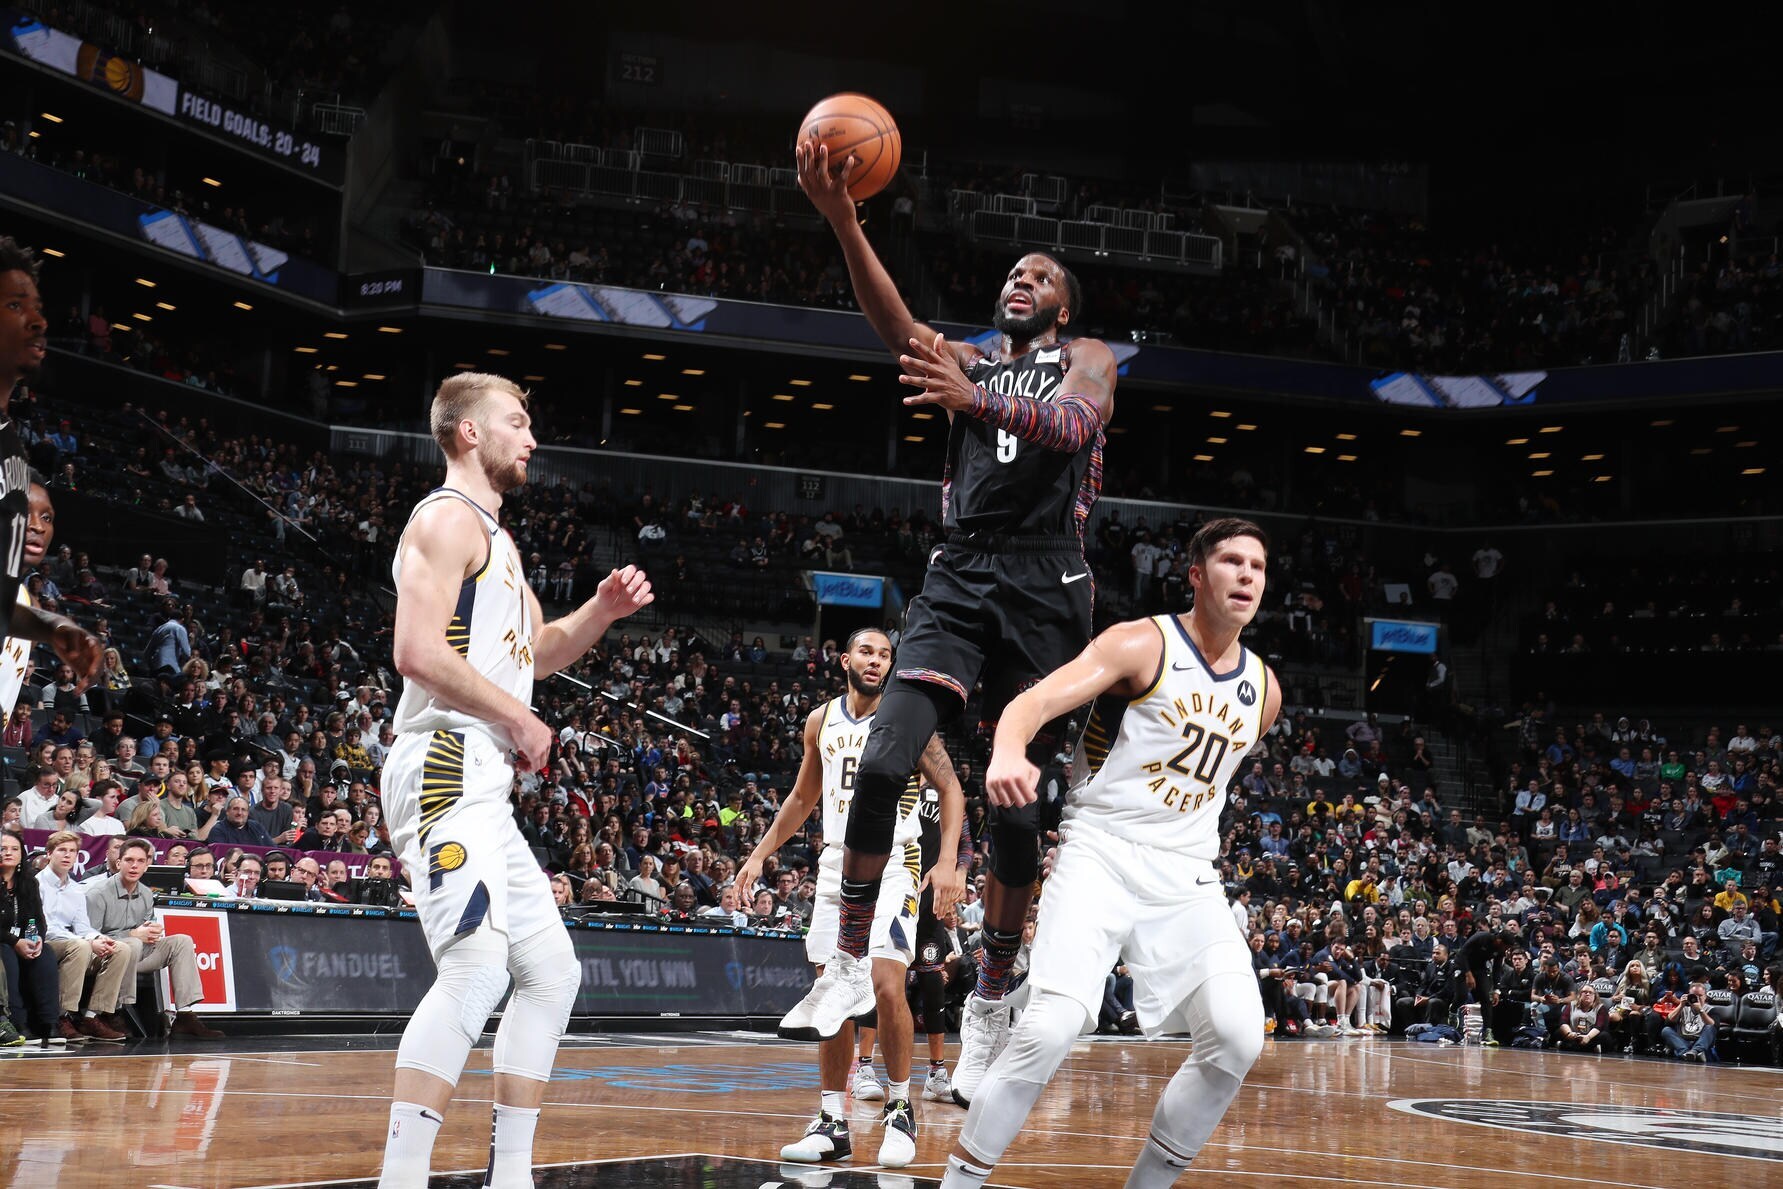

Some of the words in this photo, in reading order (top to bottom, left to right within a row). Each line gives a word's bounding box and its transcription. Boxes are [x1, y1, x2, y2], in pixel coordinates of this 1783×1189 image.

[181, 92, 222, 127] FIELD
[274, 131, 294, 156] 20
[1160, 692, 1247, 753] INDIANA
[1166, 721, 1229, 785] 20
[841, 756, 857, 790] 6
[1142, 761, 1216, 813] PACERS
[303, 952, 407, 979] FANDUEL
[619, 959, 658, 988] YOU
[660, 961, 697, 989] WIN
[1707, 991, 1732, 999] QATAR
[1748, 993, 1774, 1001] QATAR
